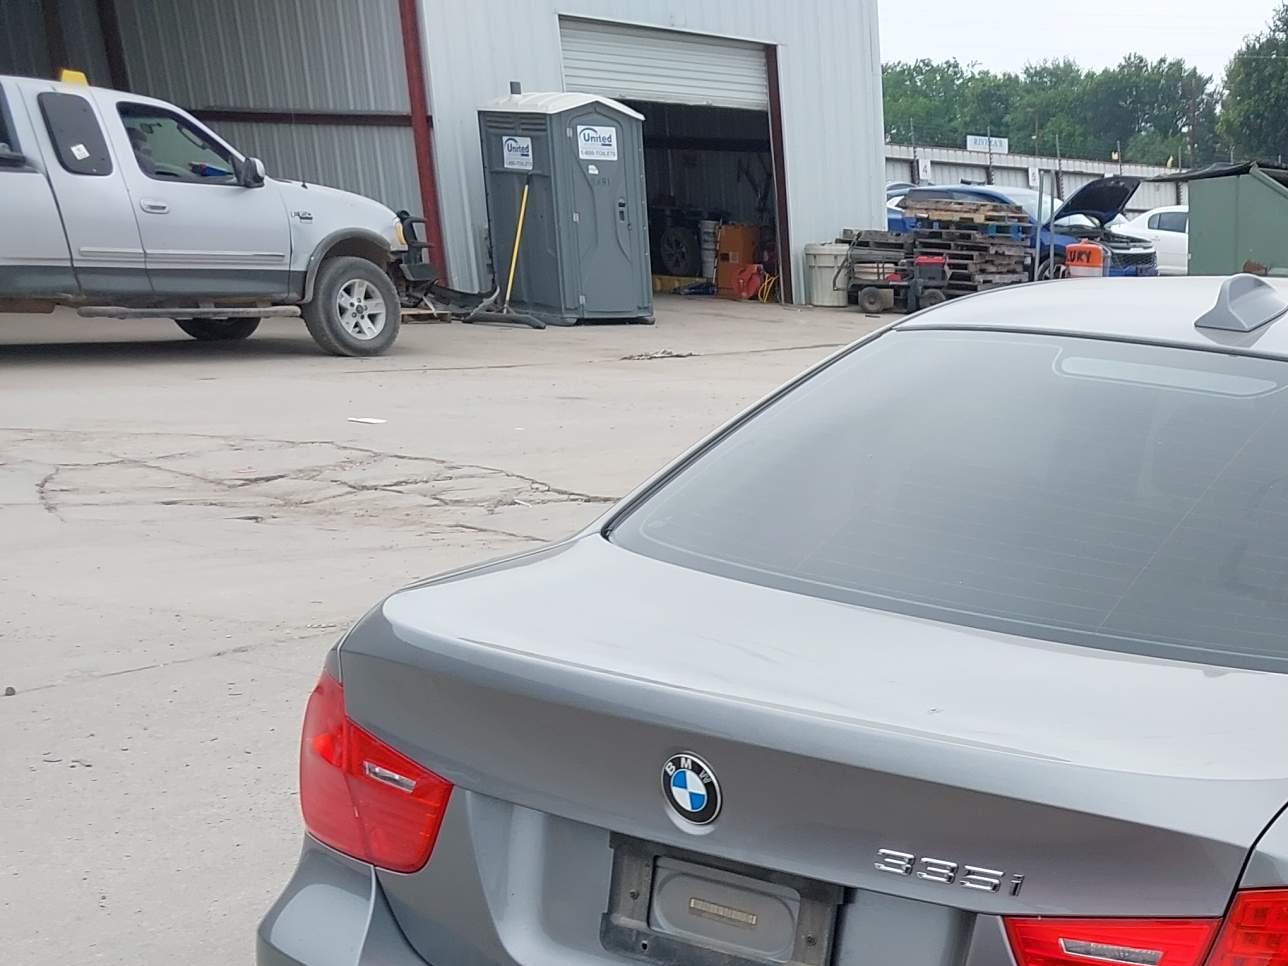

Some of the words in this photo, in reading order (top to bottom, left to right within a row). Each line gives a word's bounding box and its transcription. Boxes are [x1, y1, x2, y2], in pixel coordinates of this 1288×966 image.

[583, 132, 612, 143] United
[506, 142, 530, 153] United
[665, 757, 712, 784] BMW
[873, 848, 1025, 897] 335i
